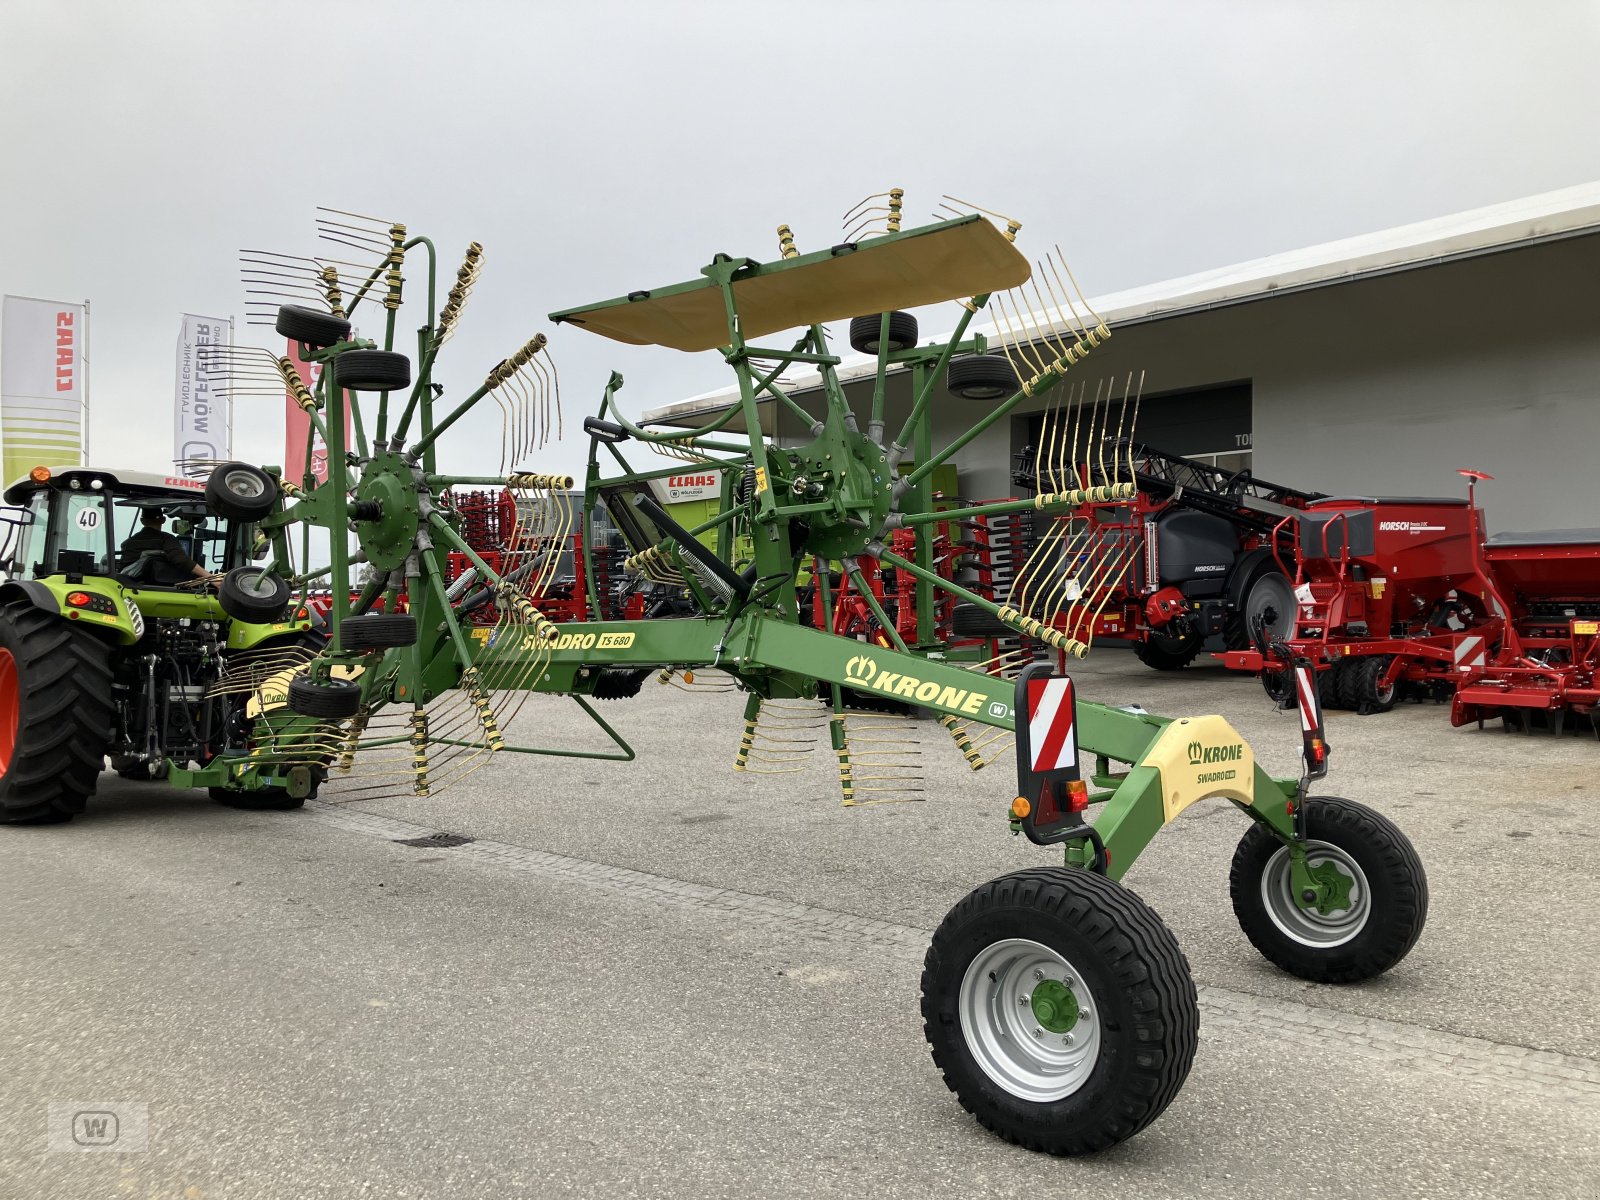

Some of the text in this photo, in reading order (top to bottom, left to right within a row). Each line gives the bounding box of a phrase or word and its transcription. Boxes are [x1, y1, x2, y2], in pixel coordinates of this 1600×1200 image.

[668, 475, 715, 487] CLAAS
[80, 510, 97, 527] 40
[1380, 521, 1410, 531] HORSCH
[601, 636, 611, 646] TS
[613, 635, 631, 646] 680
[872, 670, 988, 714] KRONE
[1203, 744, 1243, 764] KRONE
[1197, 771, 1225, 784] SWADRO
